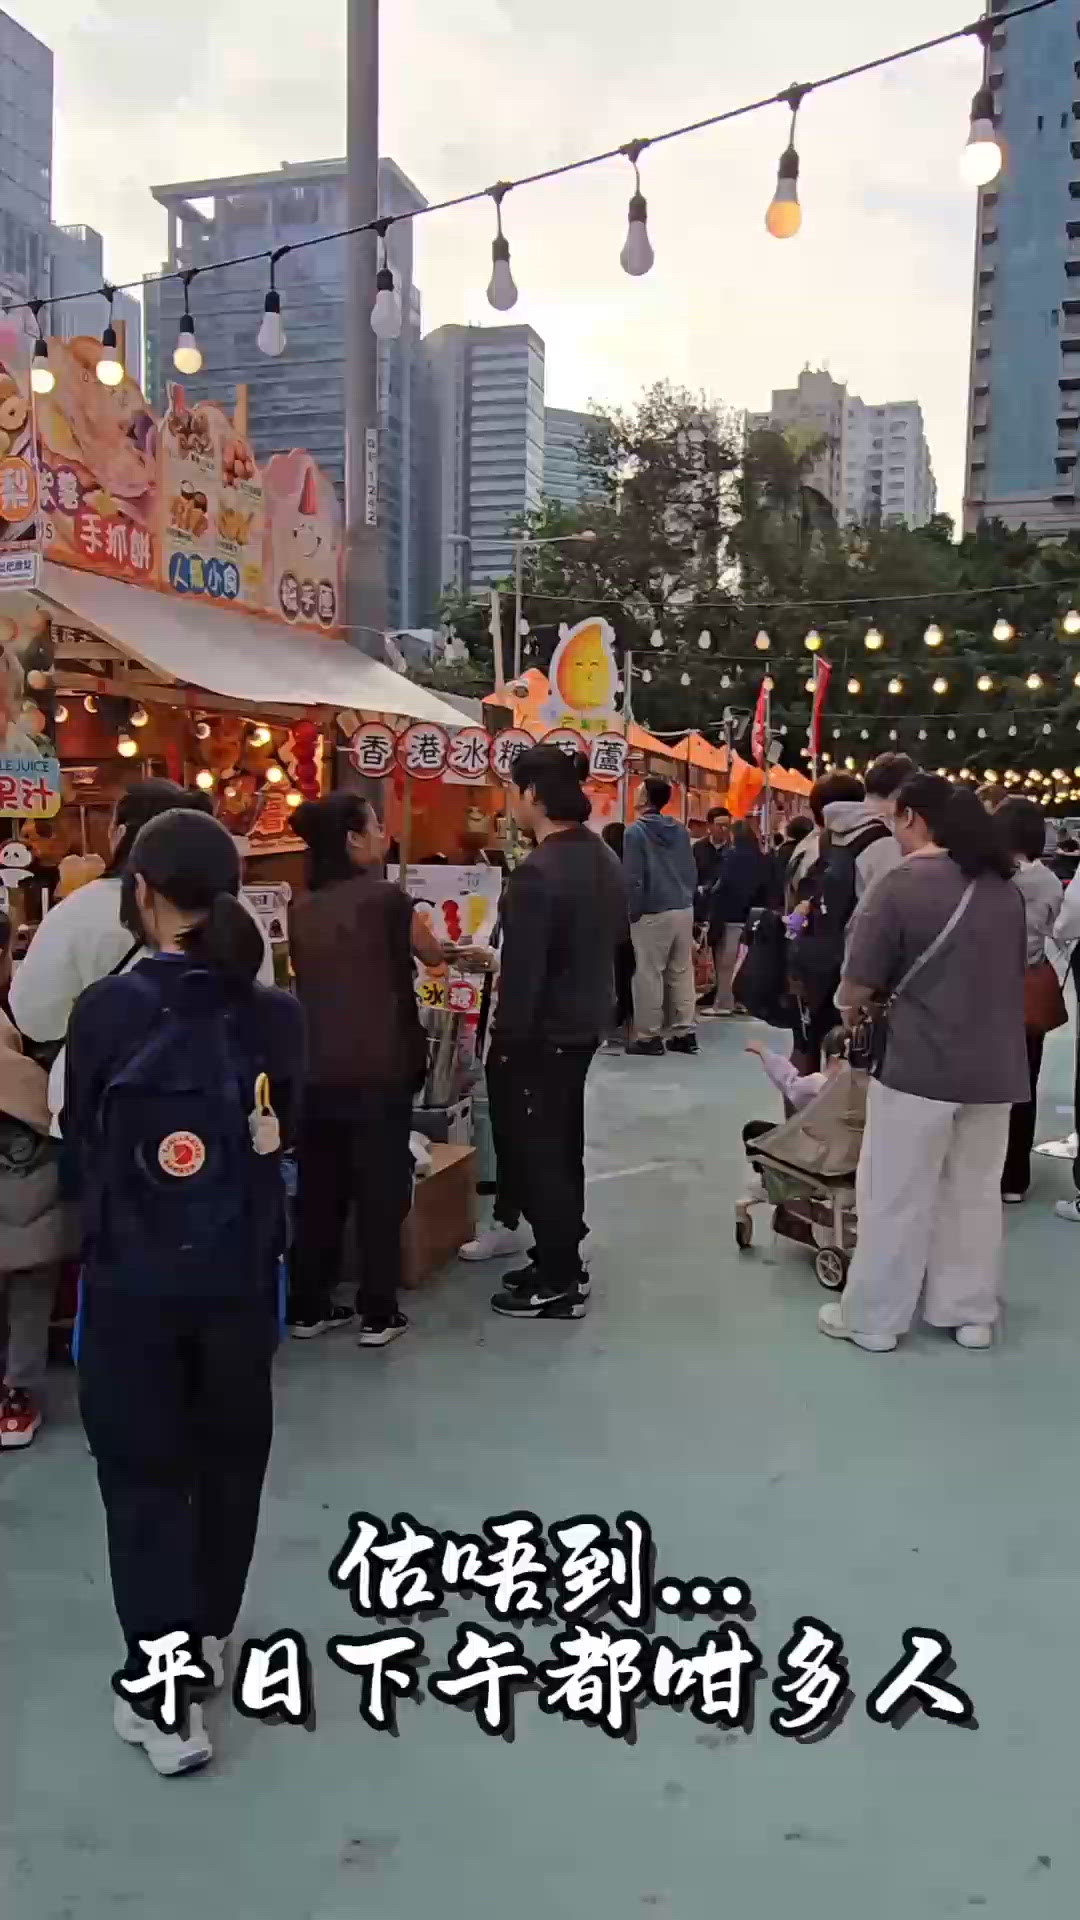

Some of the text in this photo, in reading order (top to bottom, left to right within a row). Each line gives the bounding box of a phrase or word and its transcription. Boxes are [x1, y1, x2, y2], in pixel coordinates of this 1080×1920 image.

[360, 733, 623, 772] 香港冰糖蘆
[16, 761, 48, 772] JUICE
